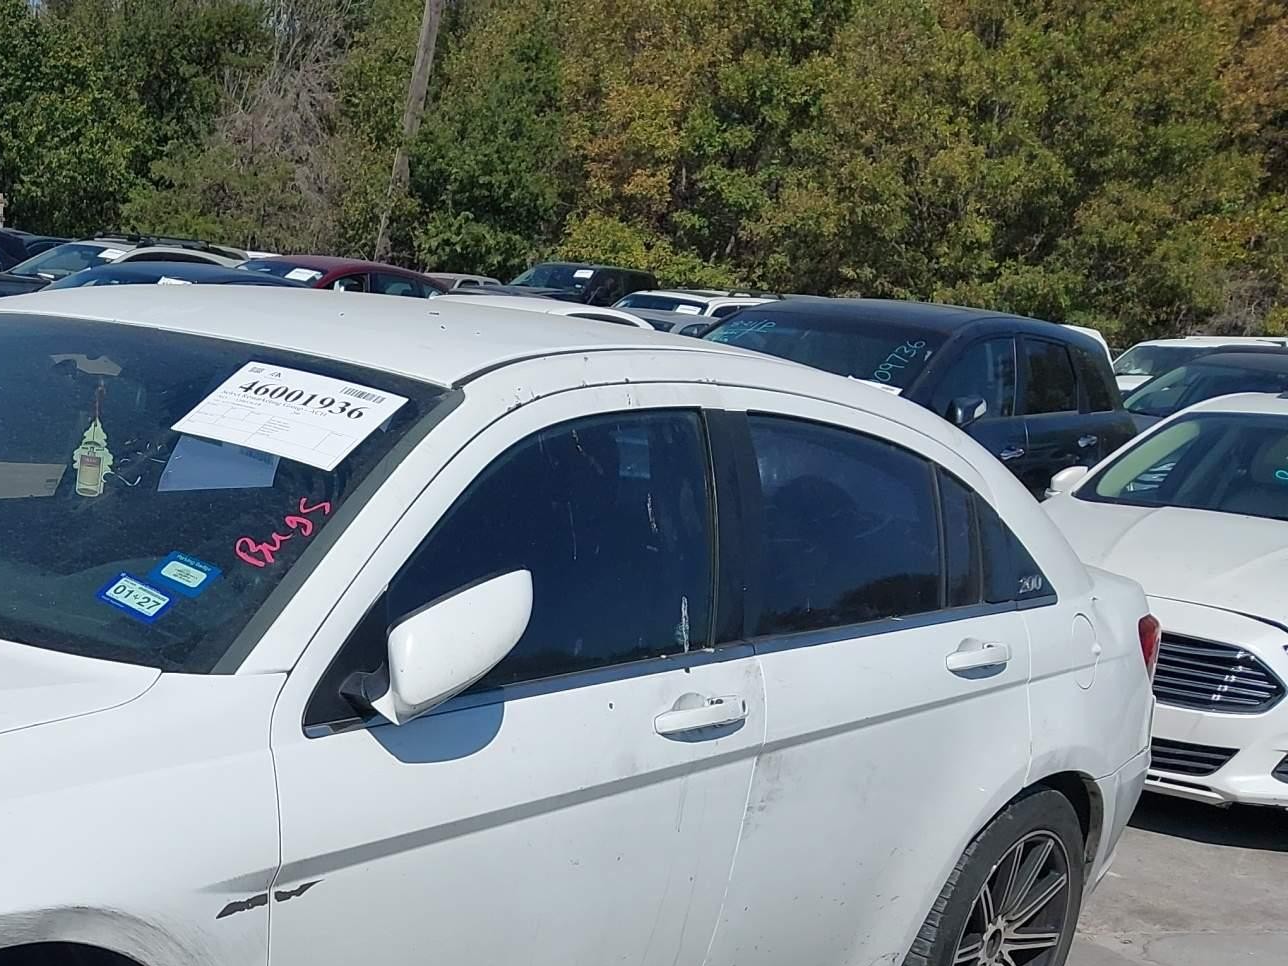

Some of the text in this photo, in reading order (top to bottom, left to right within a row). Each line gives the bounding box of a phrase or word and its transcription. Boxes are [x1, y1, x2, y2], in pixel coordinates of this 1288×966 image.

[871, 340, 926, 382] 09736
[239, 379, 369, 420] 46001936
[1018, 575, 1042, 594] 200
